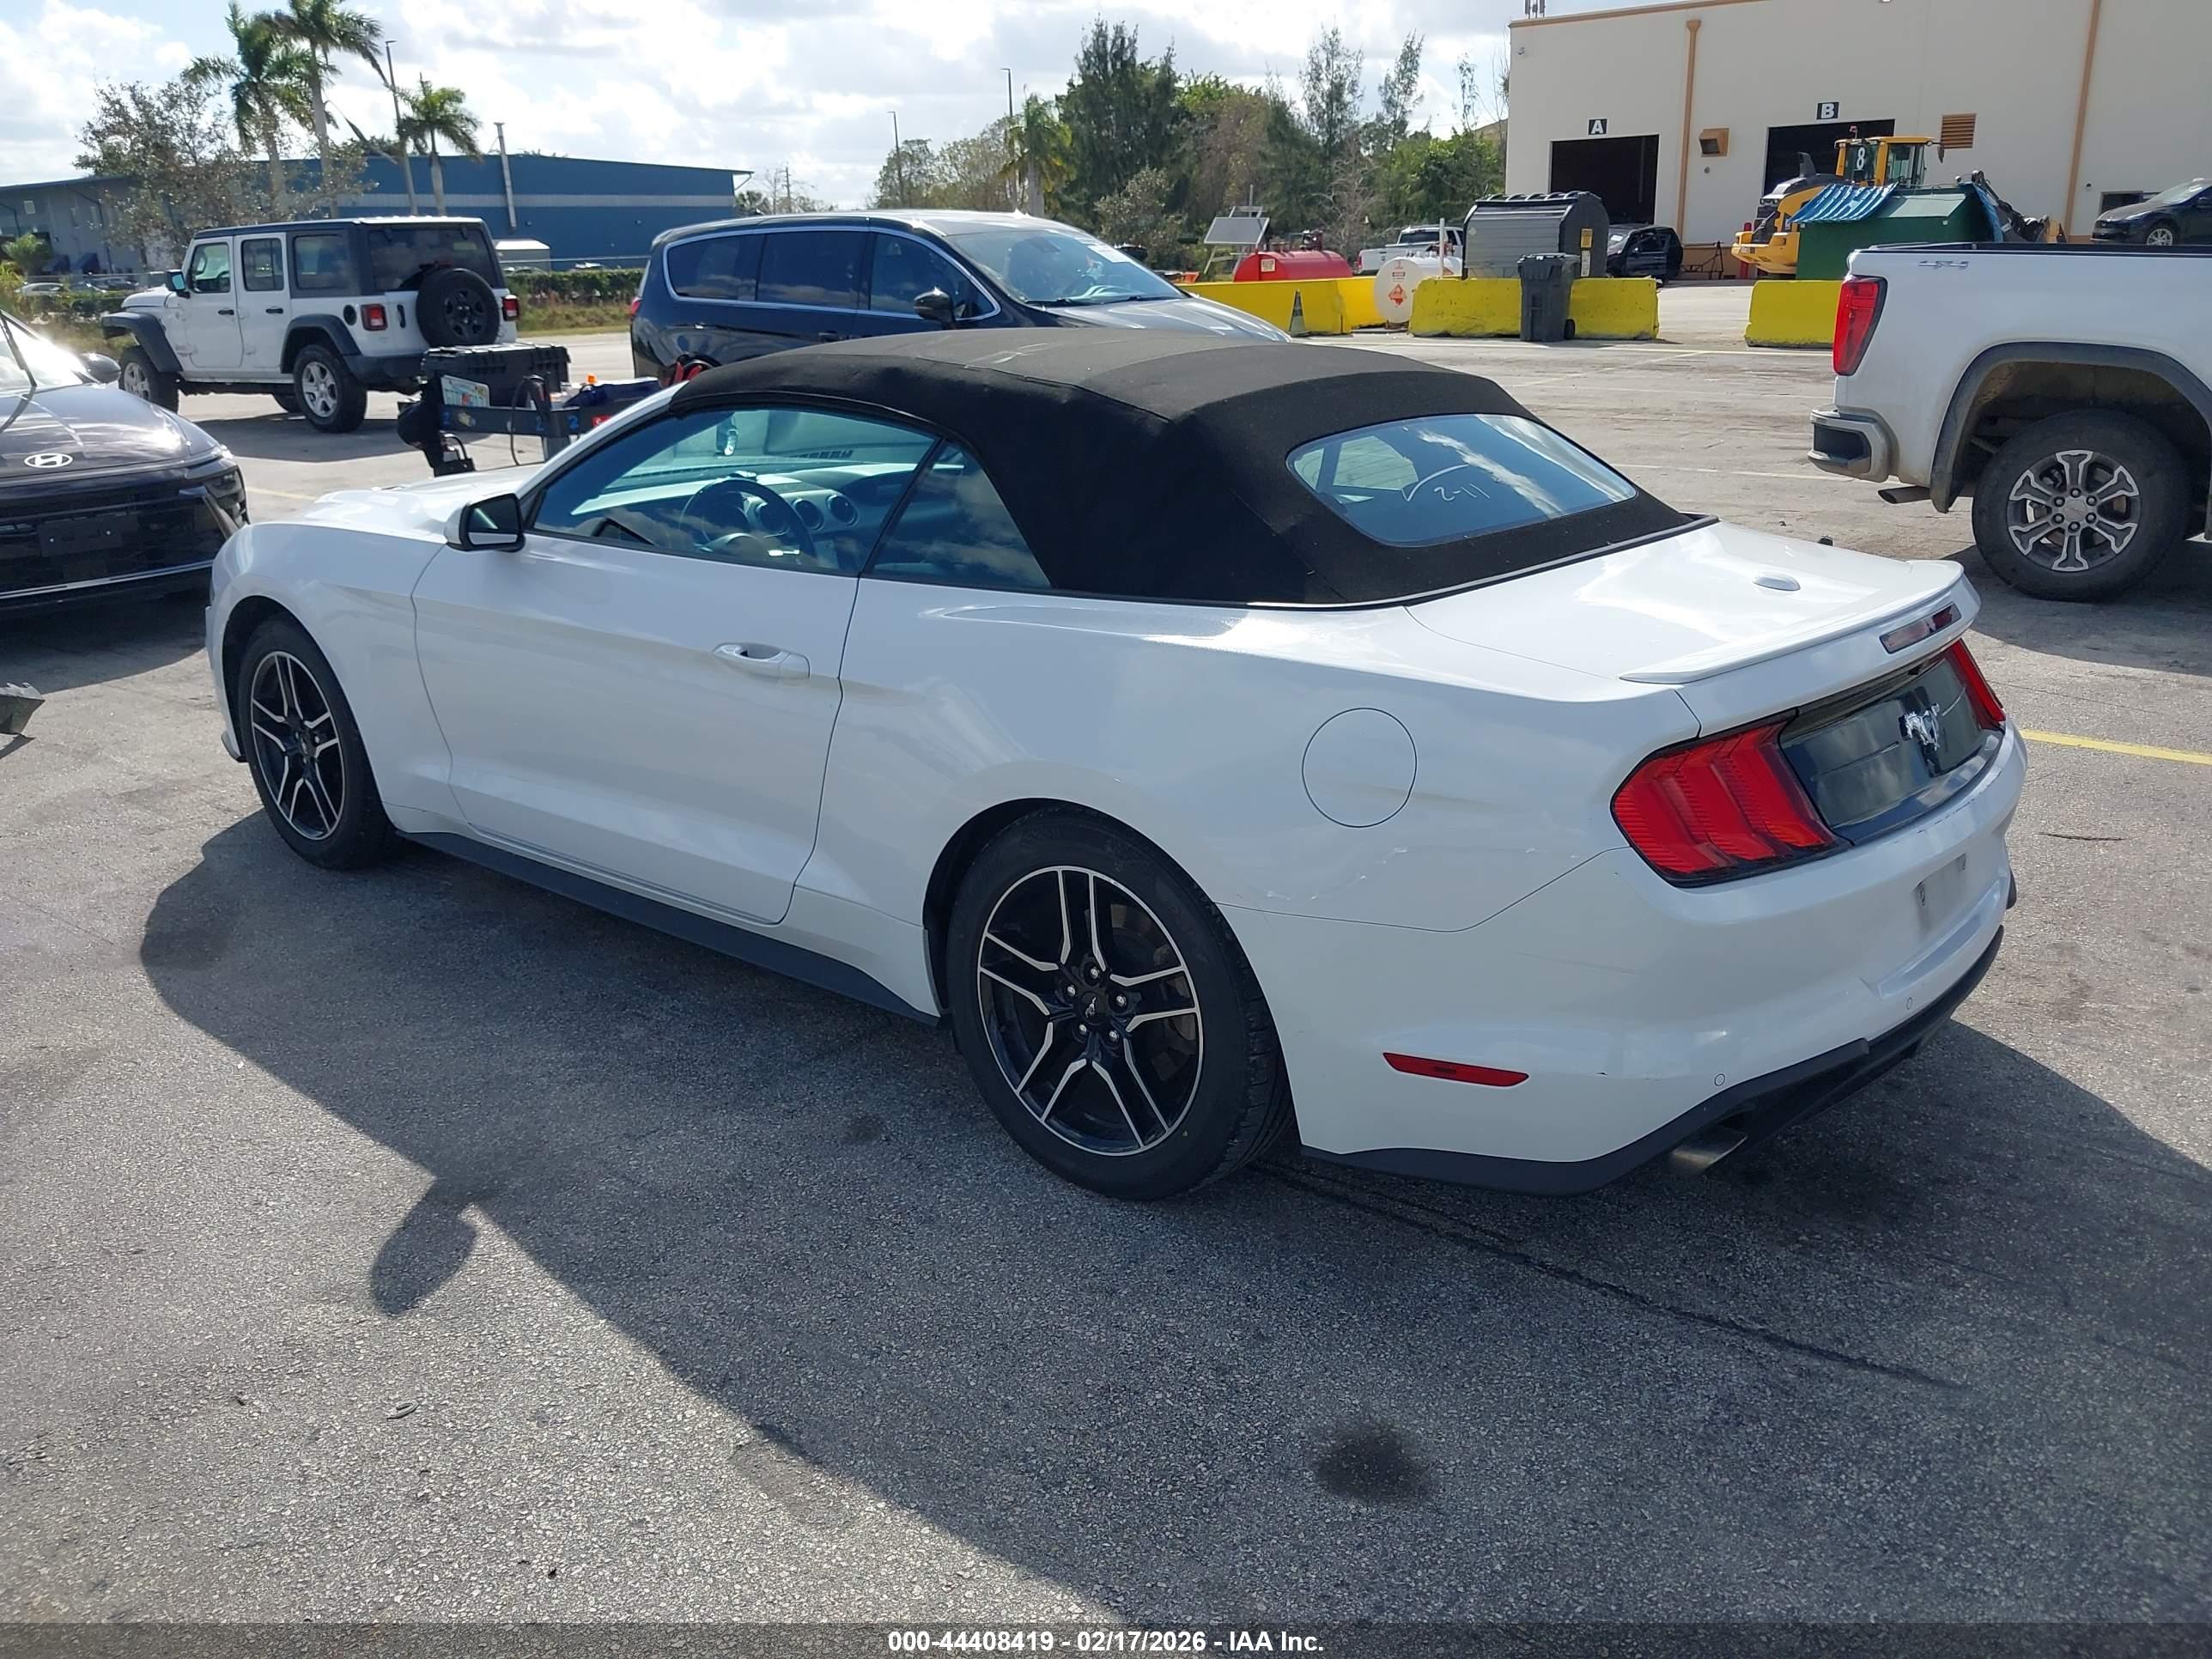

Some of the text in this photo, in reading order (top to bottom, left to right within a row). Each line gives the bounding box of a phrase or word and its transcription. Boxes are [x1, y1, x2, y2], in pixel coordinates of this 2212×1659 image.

[1821, 103, 1835, 118] B
[1590, 119, 1604, 134] A
[1856, 147, 1866, 170] 8
[1433, 483, 1491, 501] 2-11
